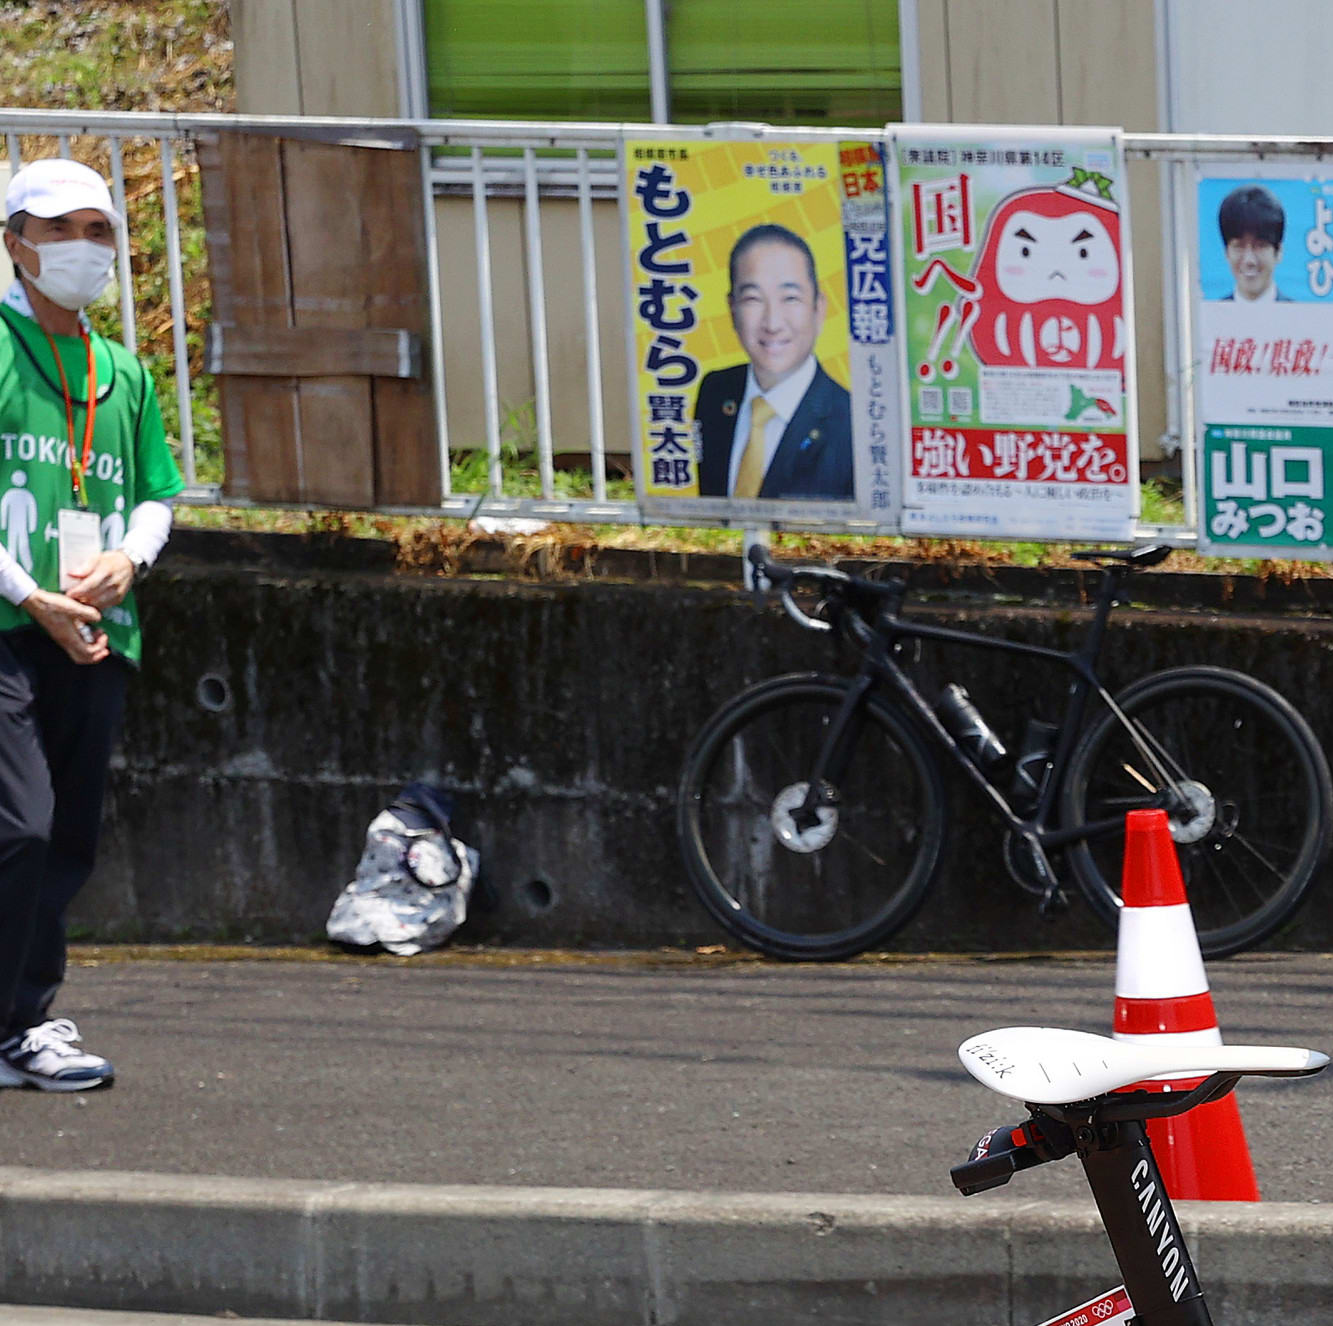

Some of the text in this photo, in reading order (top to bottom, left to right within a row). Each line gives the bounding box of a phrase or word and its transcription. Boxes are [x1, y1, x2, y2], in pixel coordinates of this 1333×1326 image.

[83, 452, 124, 485] 202
[1211, 441, 1325, 501] 山口
[1211, 500, 1325, 542] みつお
[1130, 1158, 1191, 1303] CANYON
